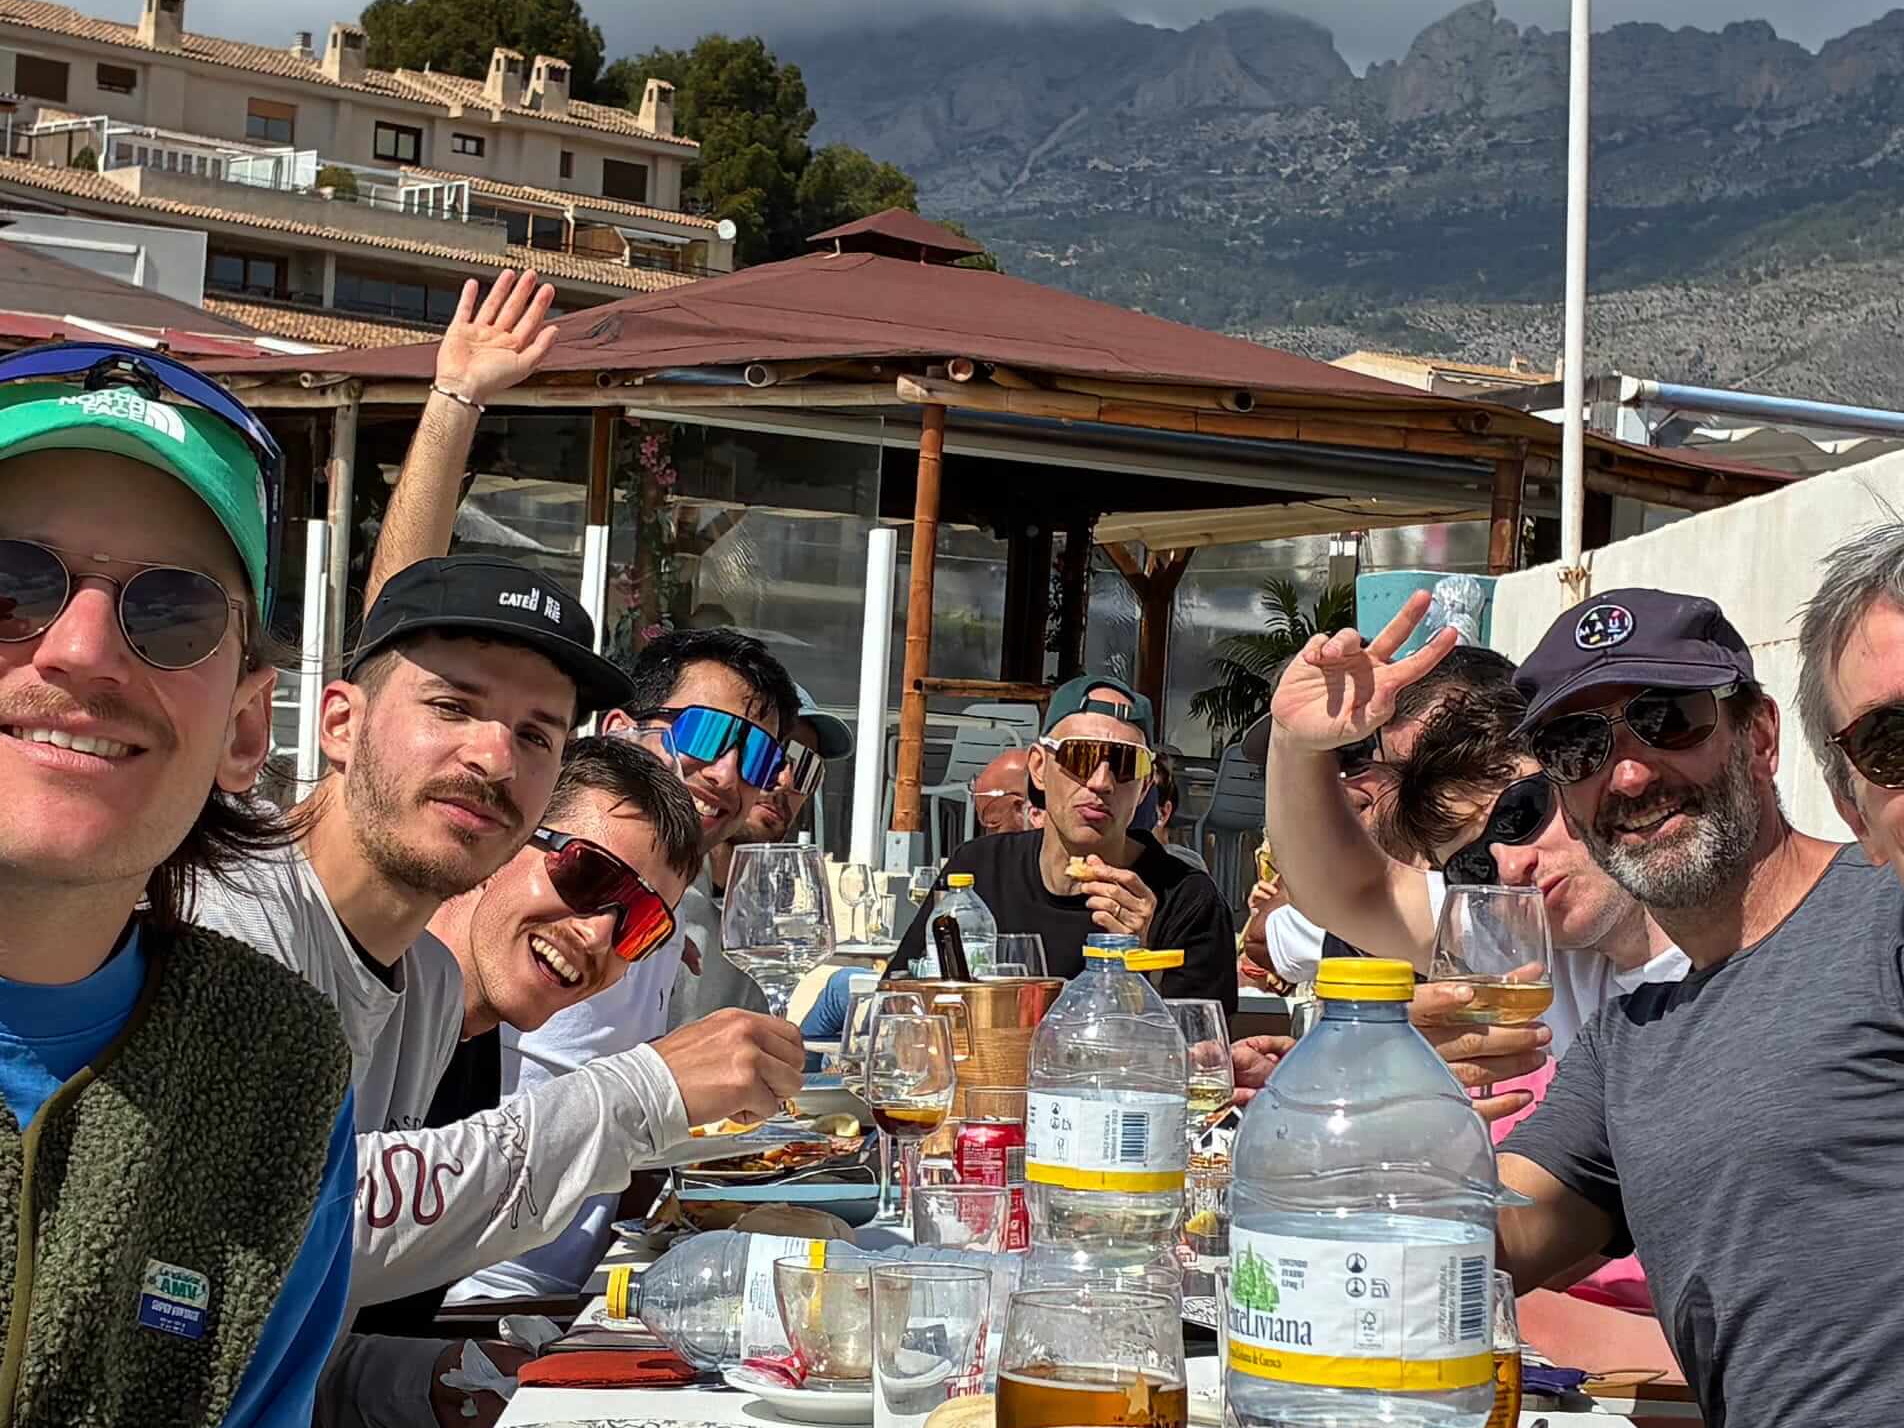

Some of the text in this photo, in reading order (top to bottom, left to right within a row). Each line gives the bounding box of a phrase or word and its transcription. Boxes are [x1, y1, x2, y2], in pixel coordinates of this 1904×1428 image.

[59, 394, 145, 413] NORTH
[83, 403, 145, 422] FACE
[1578, 616, 1629, 637] MAUI
